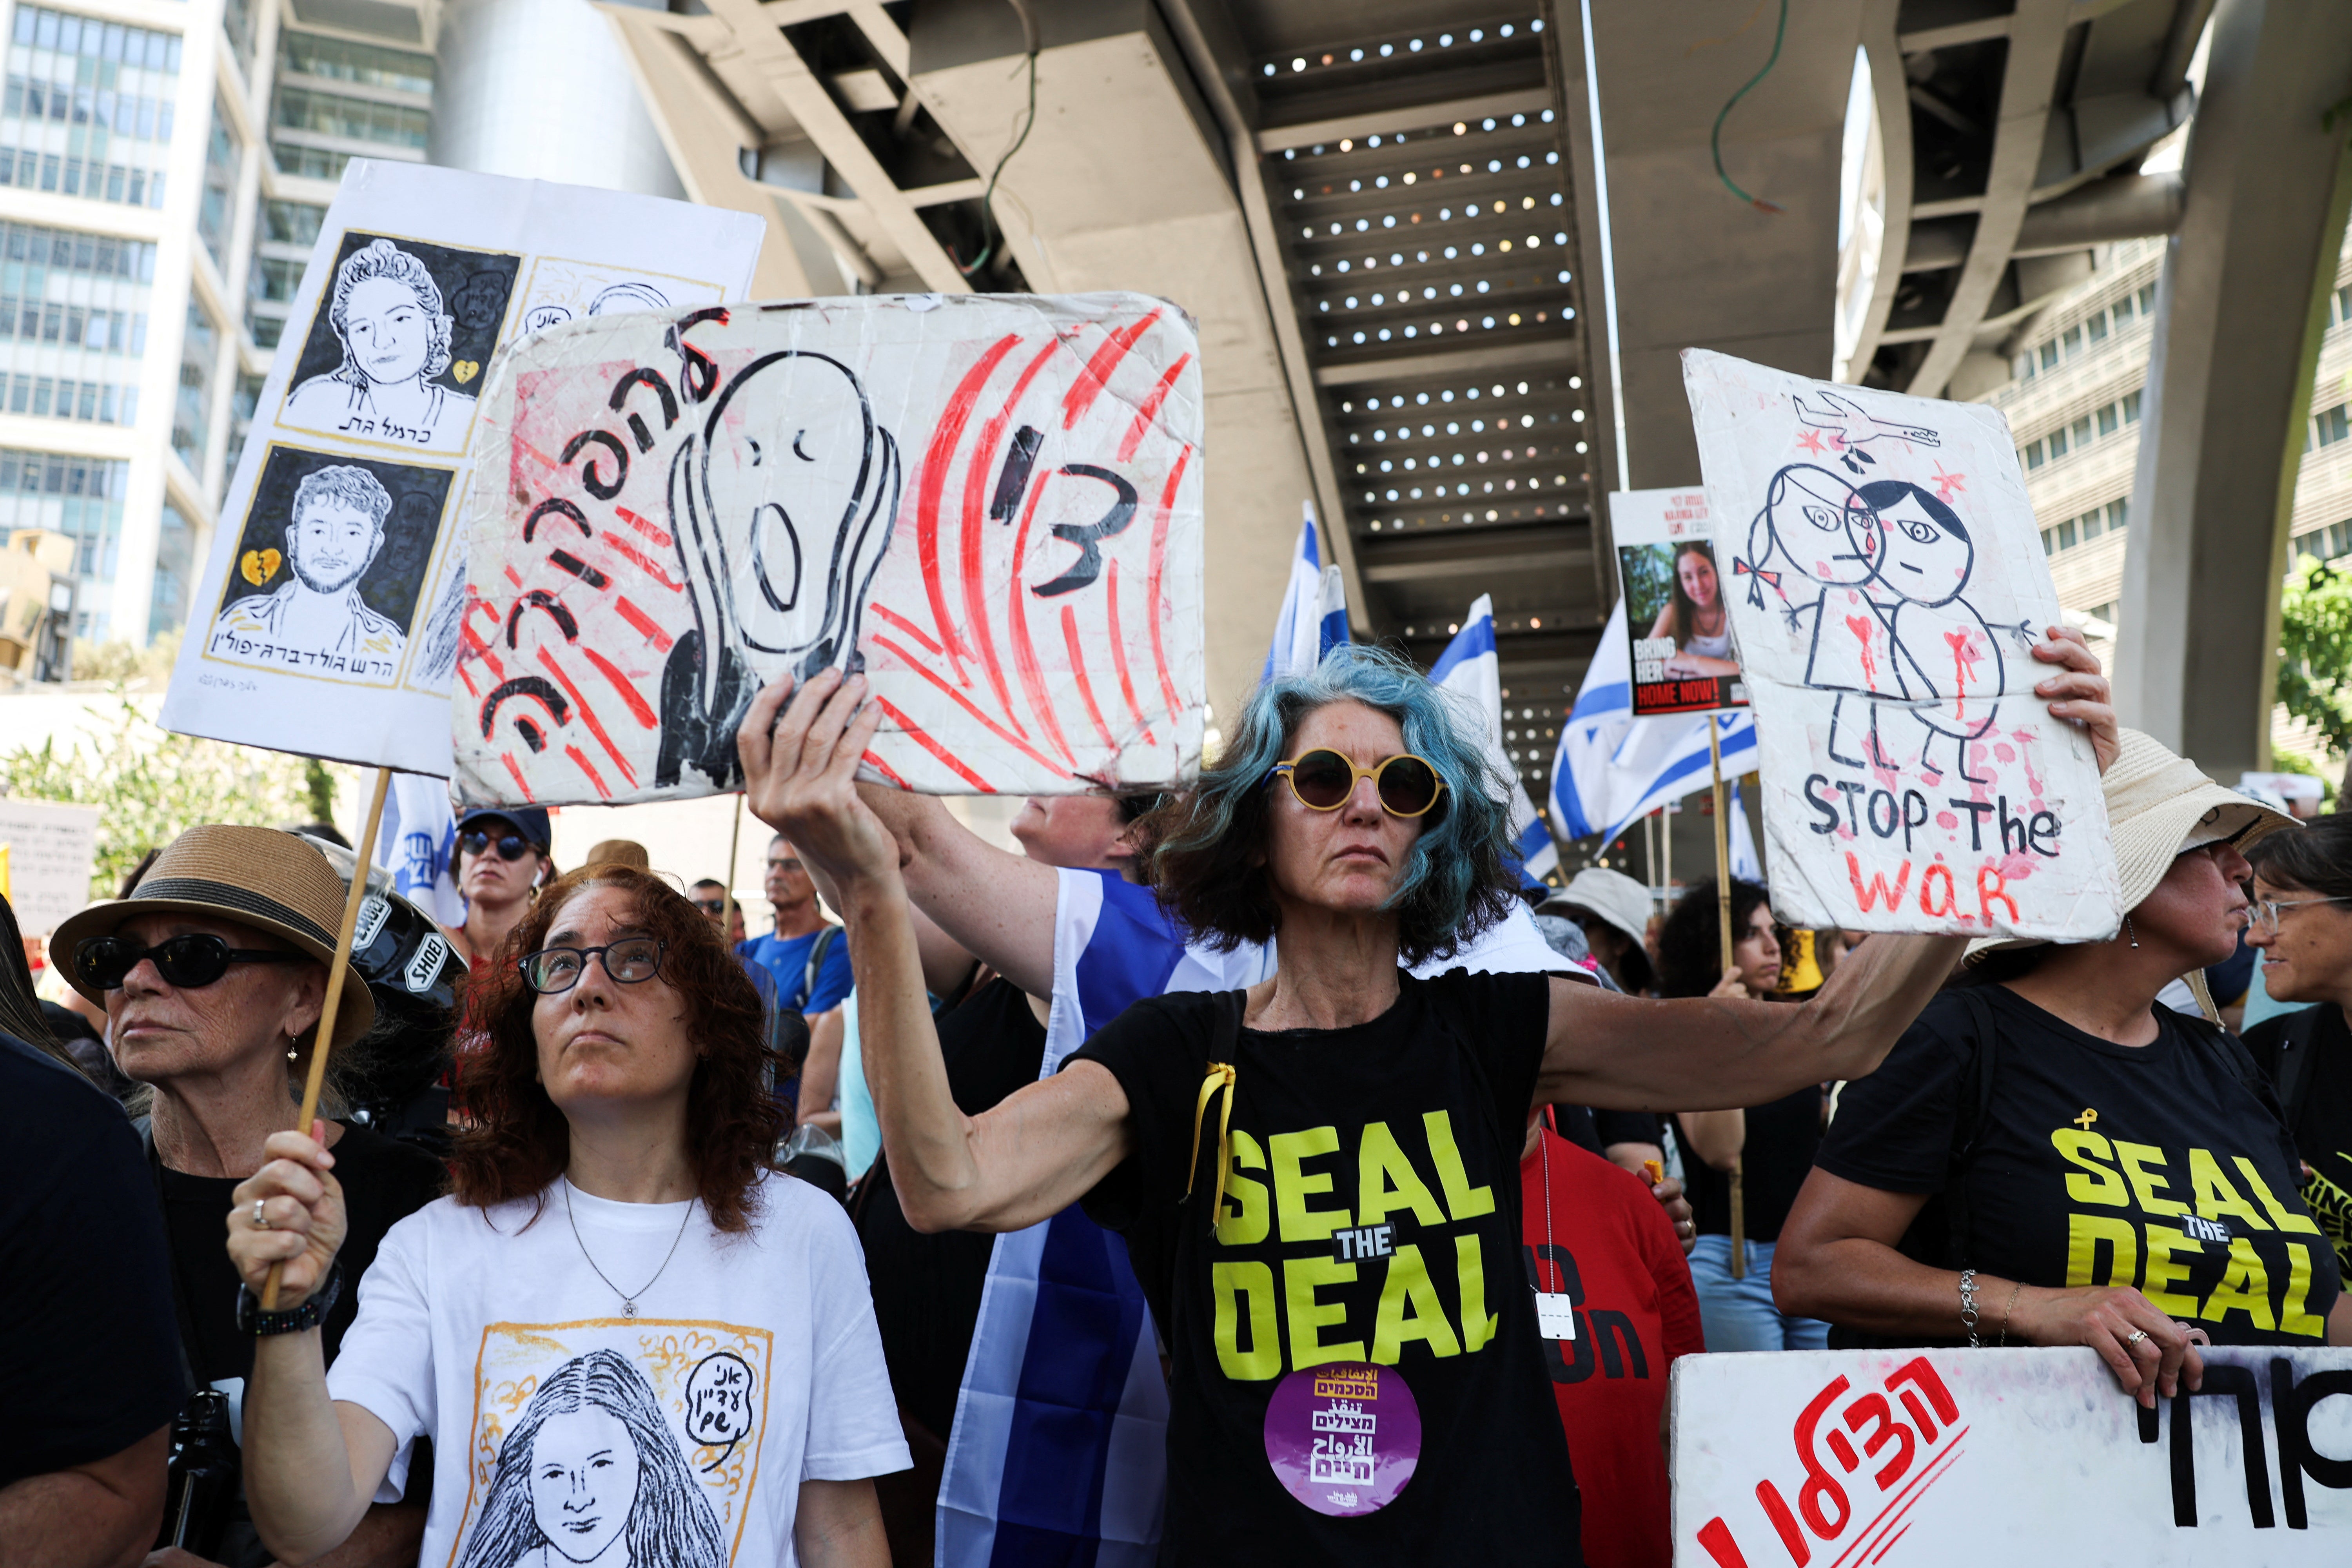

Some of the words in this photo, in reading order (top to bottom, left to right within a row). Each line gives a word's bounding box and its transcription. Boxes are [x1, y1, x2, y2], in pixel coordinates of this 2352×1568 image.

[338, 417, 375, 434] גת
[382, 417, 431, 443] כרמל
[1633, 636, 1677, 661] BRING
[350, 657, 393, 677] הרש
[1635, 660, 1664, 684] HER
[1637, 683, 1678, 705] HOME
[1679, 677, 1720, 703] NOW!
[1804, 773, 1928, 853] STOP
[412, 938, 443, 984] SHOEI
[1217, 1110, 1496, 1246] SEAL
[2051, 1127, 2322, 1236] SEAL
[2182, 1215, 2229, 1242] THE
[1336, 1226, 1392, 1259] THE
[2066, 1212, 2324, 1338] DEAL
[1212, 1233, 1499, 1380] DEAL
[714, 1364, 742, 1386] אני
[1317, 1382, 1375, 1397] הסכמים
[696, 1388, 742, 1418] עדיין
[1328, 1398, 1363, 1415] تنقذ
[699, 1411, 731, 1433] שם
[1316, 1416, 1373, 1430] מצילים
[1312, 1434, 1373, 1460] الأرواح
[1315, 1459, 1370, 1480] חיים
